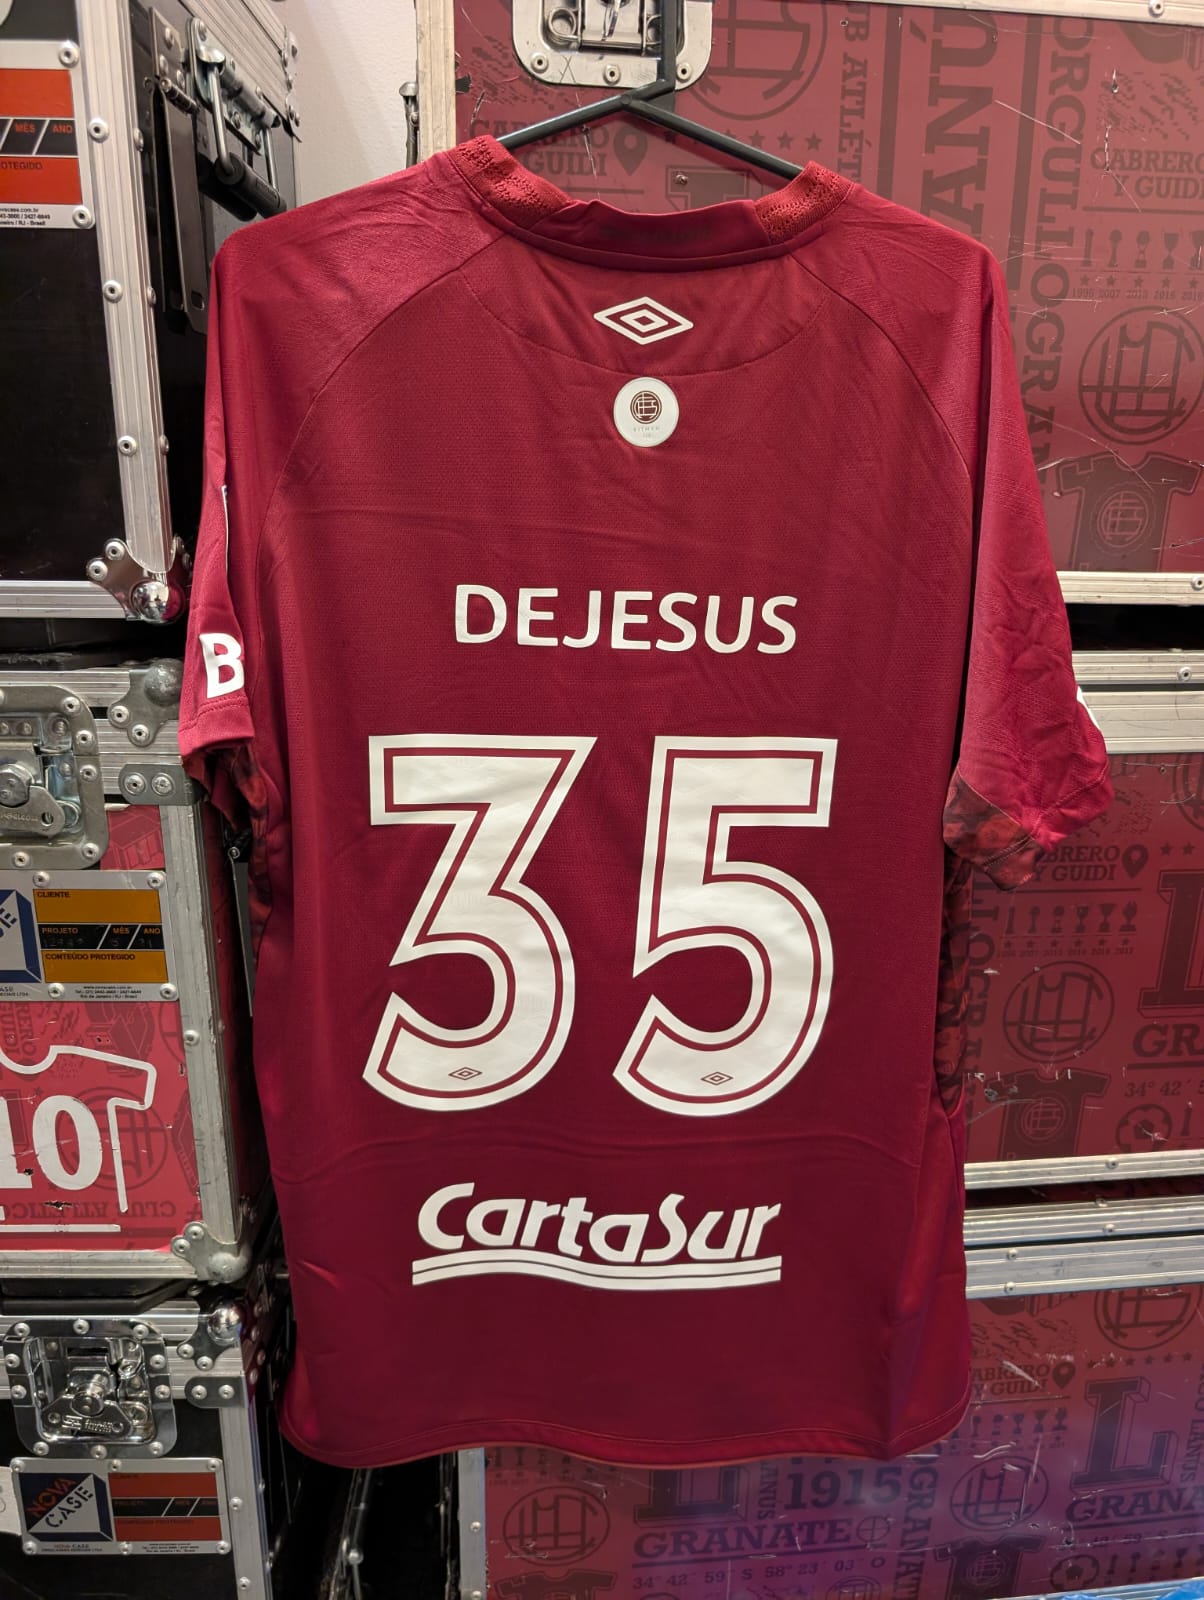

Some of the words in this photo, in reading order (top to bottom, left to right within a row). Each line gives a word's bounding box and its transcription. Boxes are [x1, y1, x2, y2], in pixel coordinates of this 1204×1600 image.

[52, 124, 73, 134] ANO
[1113, 175, 1129, 196] Y
[454, 583, 798, 655] DEJESUS
[199, 632, 245, 698] B
[1051, 864, 1118, 882] GUIDI
[42, 927, 79, 935] PROJETO
[112, 926, 131, 934] MÊS
[143, 927, 161, 935] ANO
[362, 733, 839, 1117] 35
[90, 953, 136, 961] PROTEGIDO
[417, 1182, 782, 1264] CartaSur
[26, 1477, 77, 1518] NOVA
[45, 1486, 94, 1528] CASE
[783, 1466, 902, 1511] 1915
[634, 1518, 854, 1559] GRANATE
